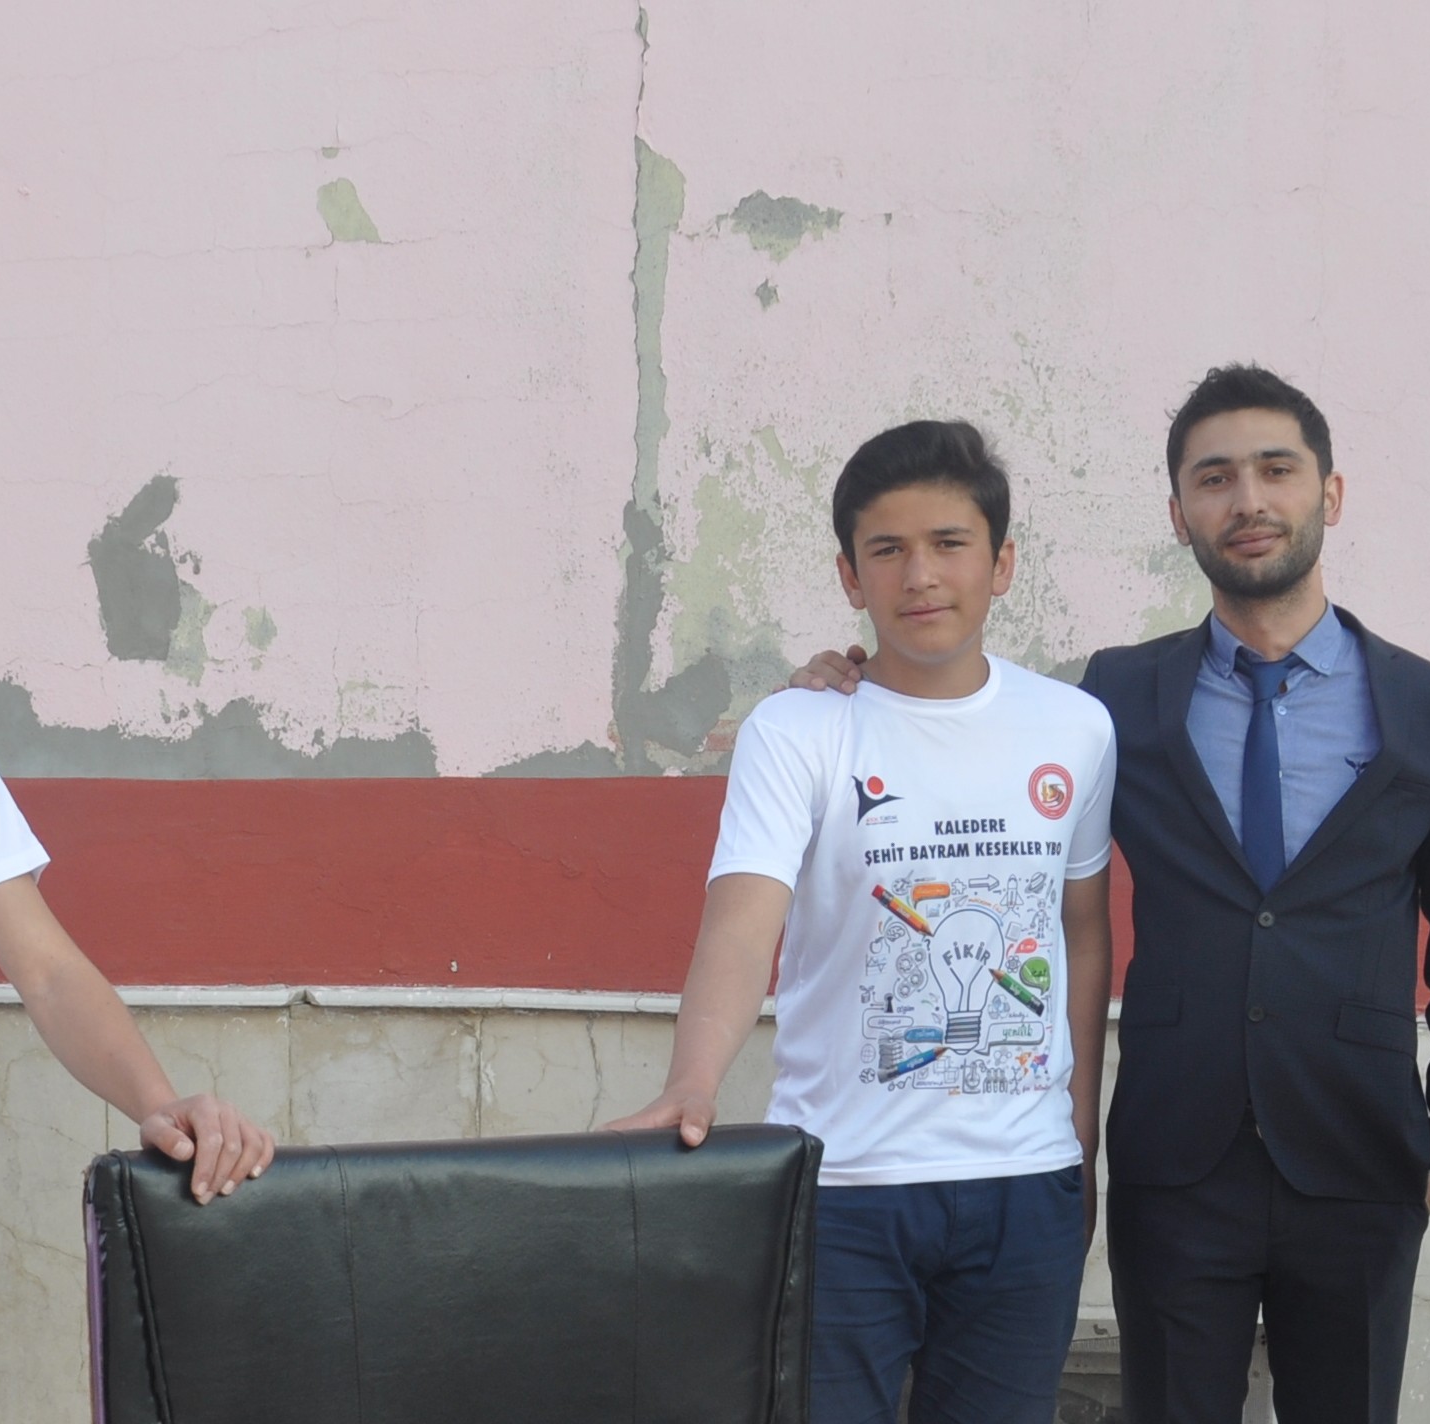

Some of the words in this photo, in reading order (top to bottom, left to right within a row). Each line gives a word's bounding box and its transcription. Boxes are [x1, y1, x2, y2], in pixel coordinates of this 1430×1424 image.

[934, 818, 1007, 836] KALEDERE
[864, 842, 905, 867] ŞEHİT
[910, 842, 970, 861] BAYRAM
[975, 840, 1043, 857] KESEKLER
[942, 941, 991, 967] FİKİR
